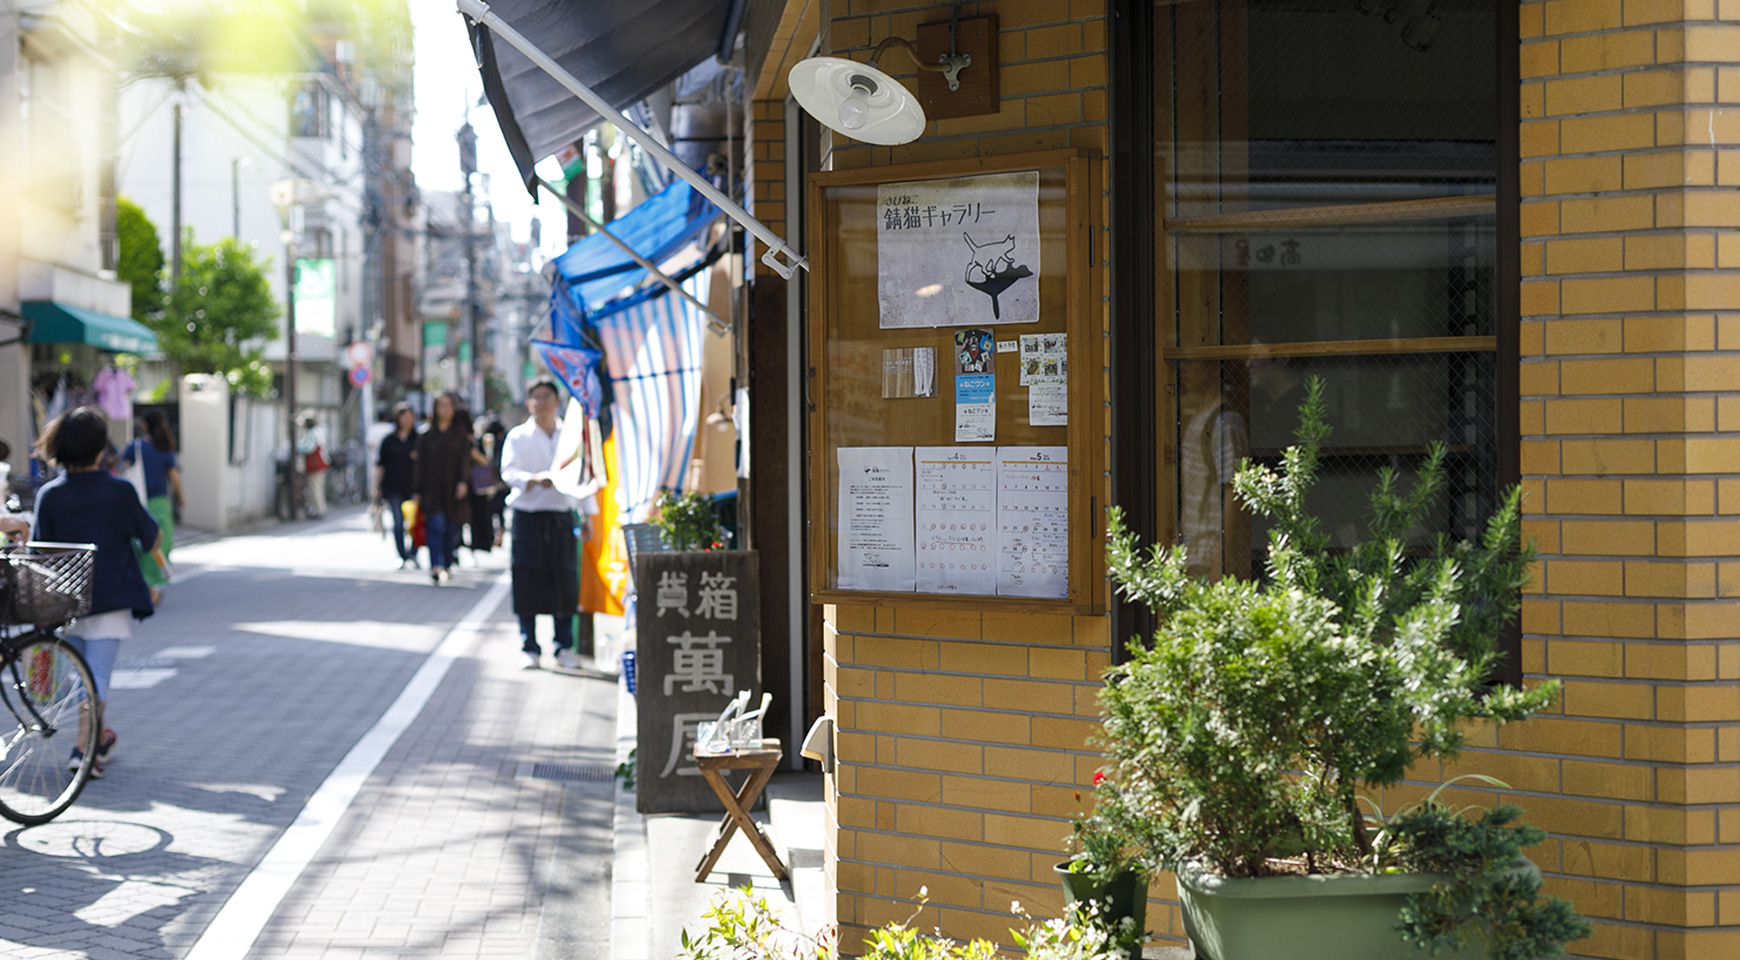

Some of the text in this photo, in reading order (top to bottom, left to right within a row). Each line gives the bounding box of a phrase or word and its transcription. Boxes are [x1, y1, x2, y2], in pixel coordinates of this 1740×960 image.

[885, 194, 919, 206] さびねこ
[883, 202, 996, 231] 錆猫ギャラリー
[953, 452, 959, 460] 4
[1036, 452, 1042, 461] 5
